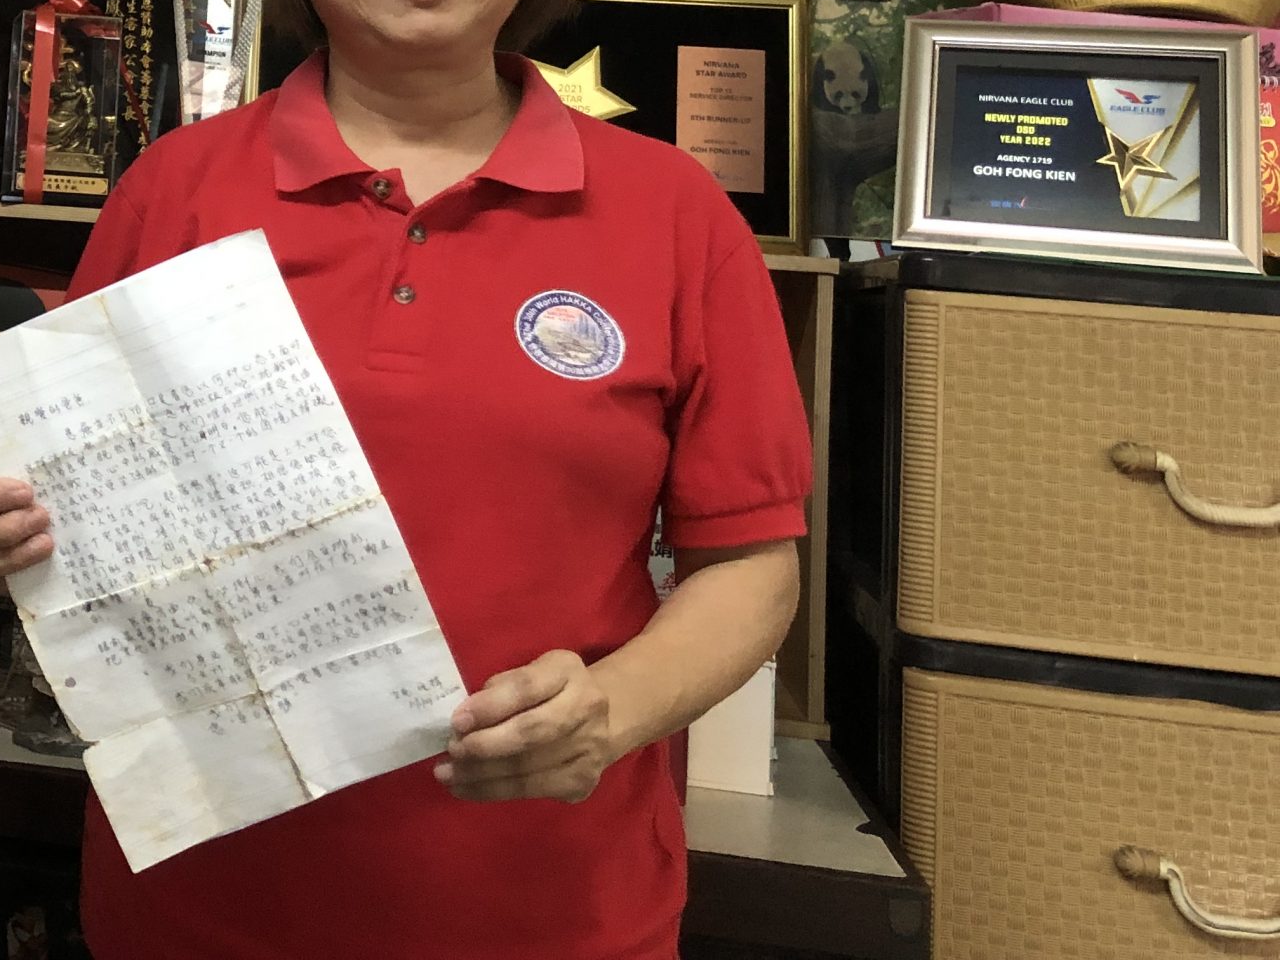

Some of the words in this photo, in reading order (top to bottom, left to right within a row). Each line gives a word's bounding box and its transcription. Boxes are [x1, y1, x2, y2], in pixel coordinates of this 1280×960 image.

[704, 61, 739, 69] NIRVANA
[718, 70, 747, 78] AWARD
[558, 84, 582, 93] 2021
[560, 95, 583, 103] STAR
[979, 95, 1018, 104] NIRVANA
[1020, 97, 1048, 105] EAGLE
[1051, 98, 1074, 106] CLUB
[1110, 105, 1137, 113] EAGLE
[1141, 106, 1166, 115] CLUB
[985, 113, 1016, 123] NEWLY
[1017, 115, 1069, 126] PROMOTED
[1000, 135, 1022, 144] YEAR
[1025, 137, 1051, 146] 2022
[997, 154, 1030, 163] AGENCY
[973, 165, 1002, 176] GOH
[1005, 167, 1042, 179] FONG
[1046, 170, 1076, 181] KIEN
[535, 296, 559, 309] World
[560, 295, 593, 313] HAKKA
